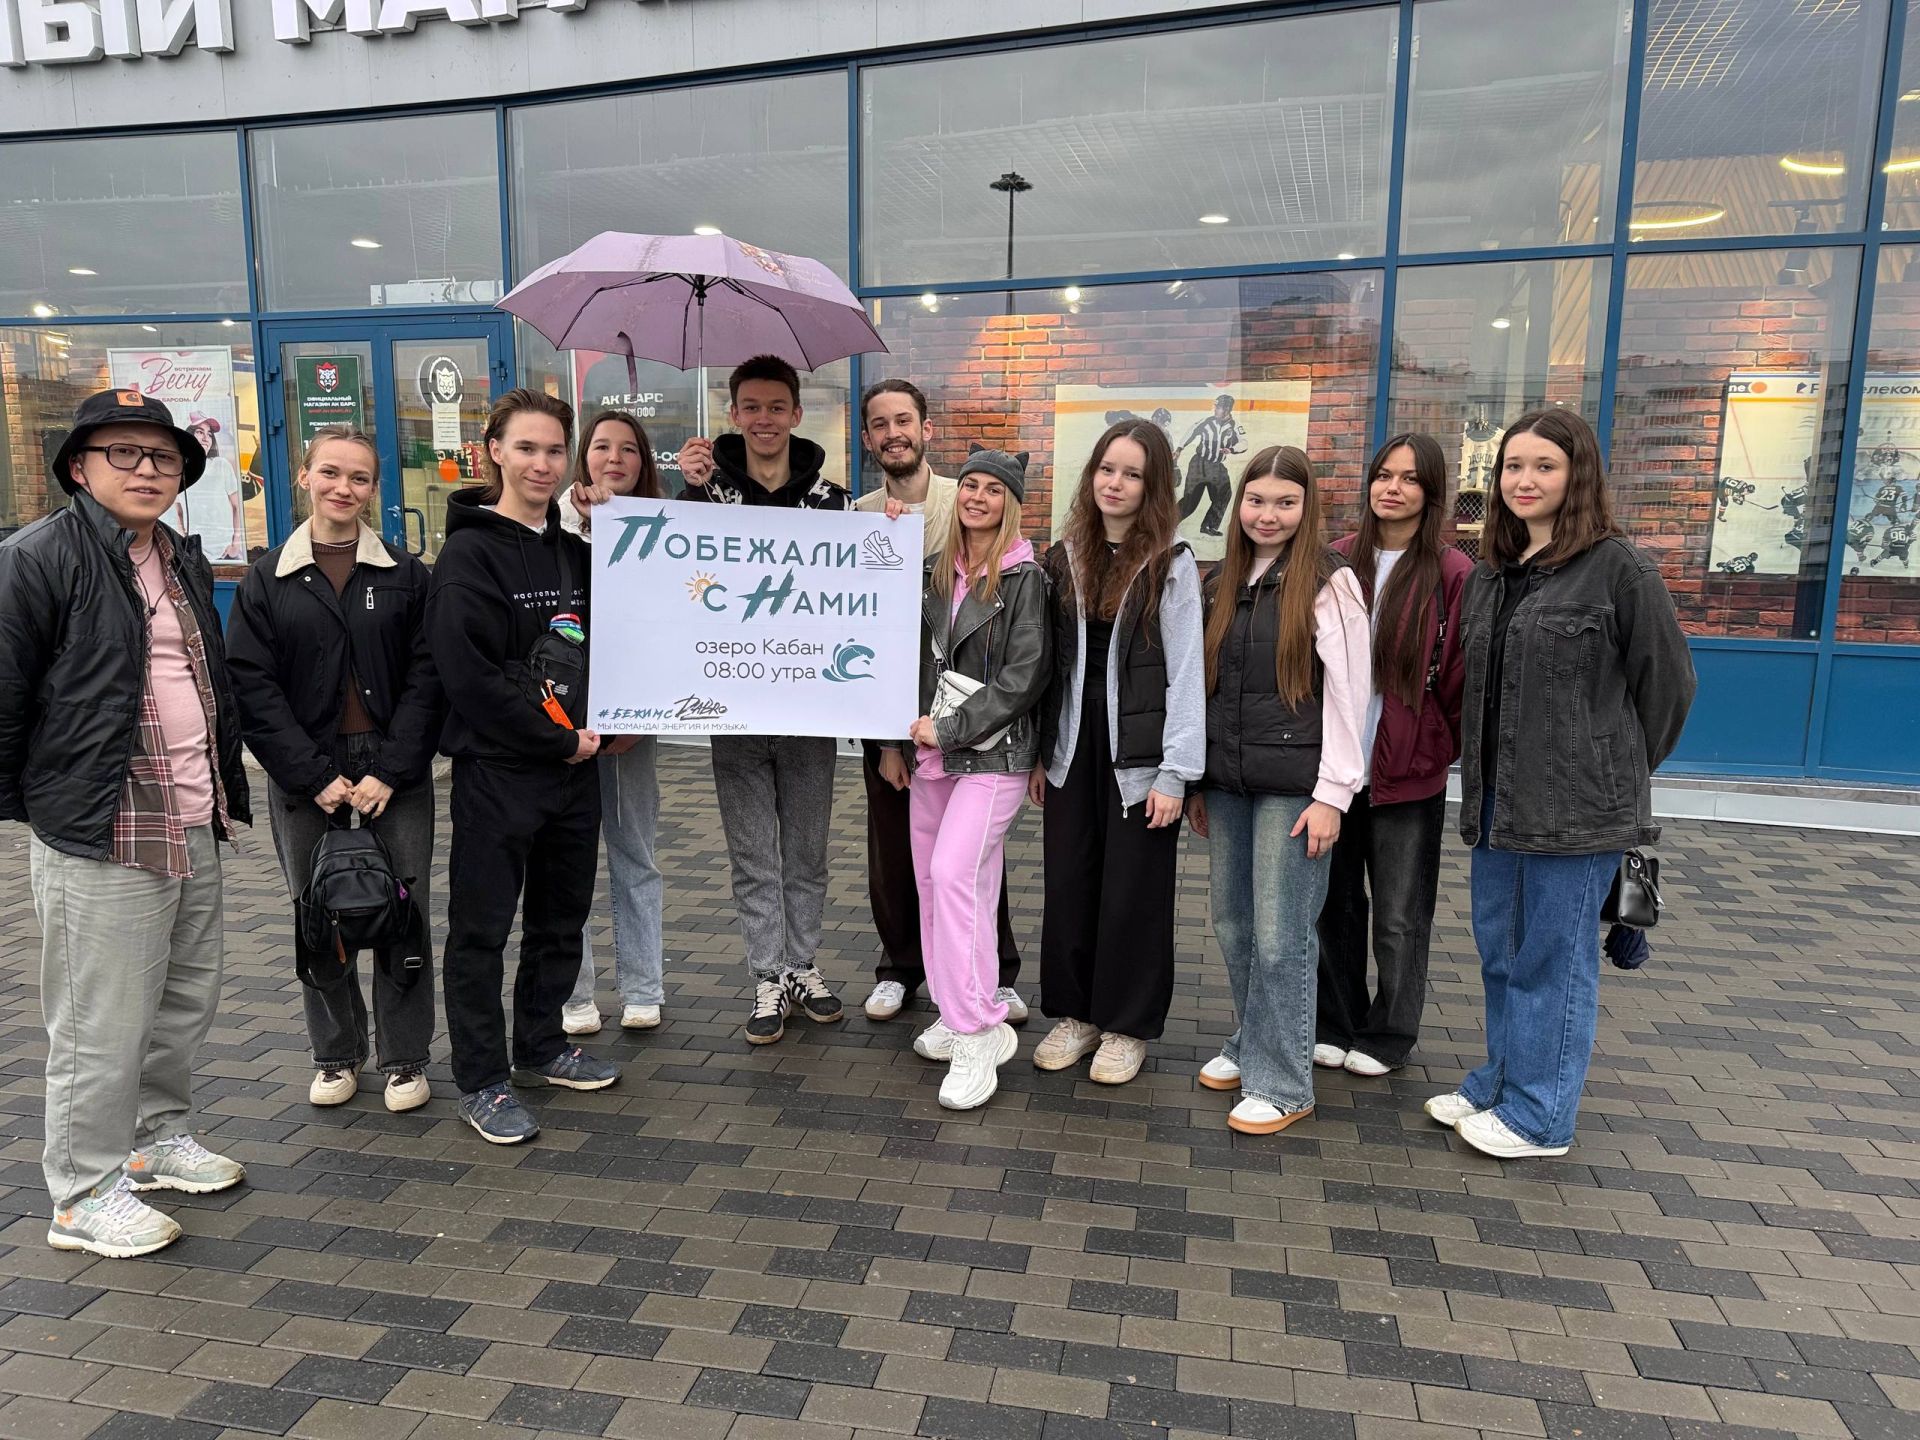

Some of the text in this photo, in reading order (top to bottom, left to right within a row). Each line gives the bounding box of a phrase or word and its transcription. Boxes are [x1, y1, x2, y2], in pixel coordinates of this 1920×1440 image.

[141, 357, 212, 401] Весну
[600, 394, 620, 406] АК
[1880, 490, 1897, 501] 23
[1890, 531, 1907, 542] 96
[695, 638, 824, 657] озеро Кабан
[703, 661, 816, 683] 08:00 утра
[661, 723, 702, 731] ЭНЕРГИЯ
[703, 723, 710, 731] И
[711, 723, 748, 731] МУЗЫКА!
